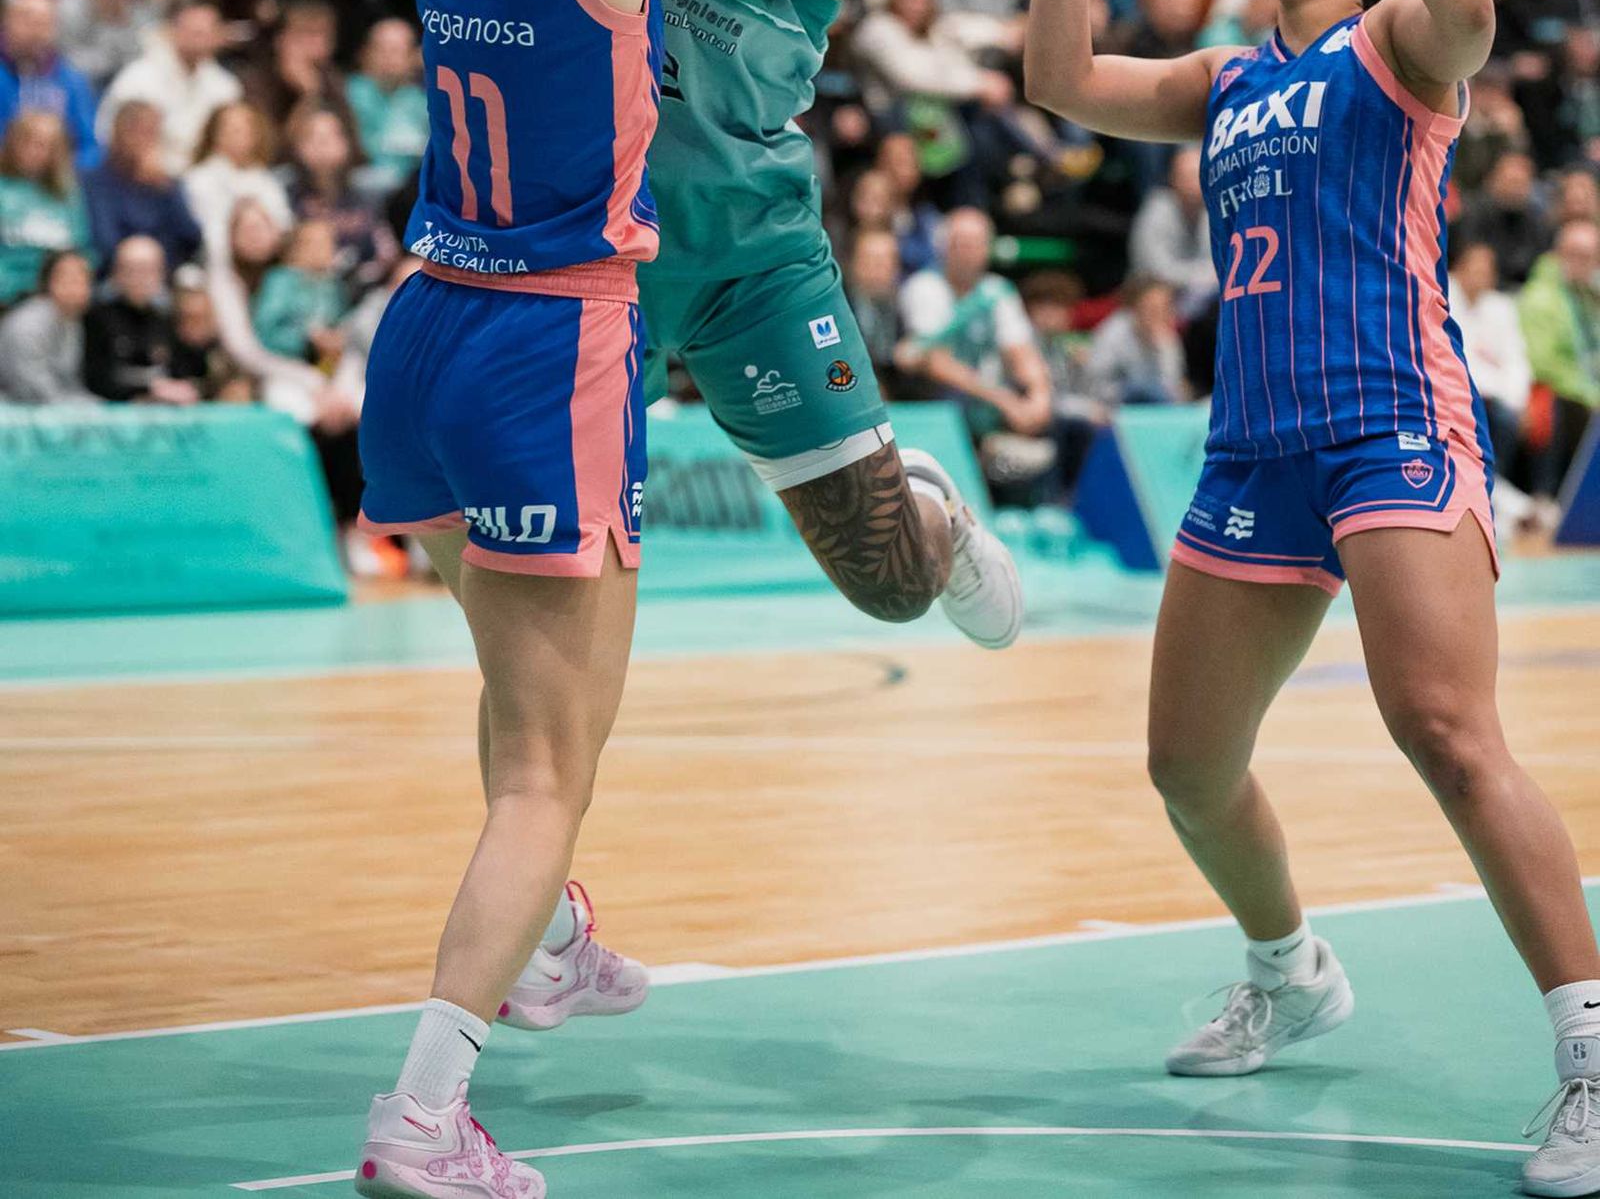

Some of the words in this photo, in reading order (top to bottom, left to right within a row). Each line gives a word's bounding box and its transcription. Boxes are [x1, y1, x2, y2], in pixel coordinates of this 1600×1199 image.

[421, 7, 535, 47] reganosa
[436, 64, 514, 228] 11
[1207, 81, 1326, 161] BAXI
[430, 230, 489, 253] XUNTA
[431, 249, 450, 265] DE
[452, 253, 529, 274] GALICIA
[1223, 225, 1282, 301] 22
